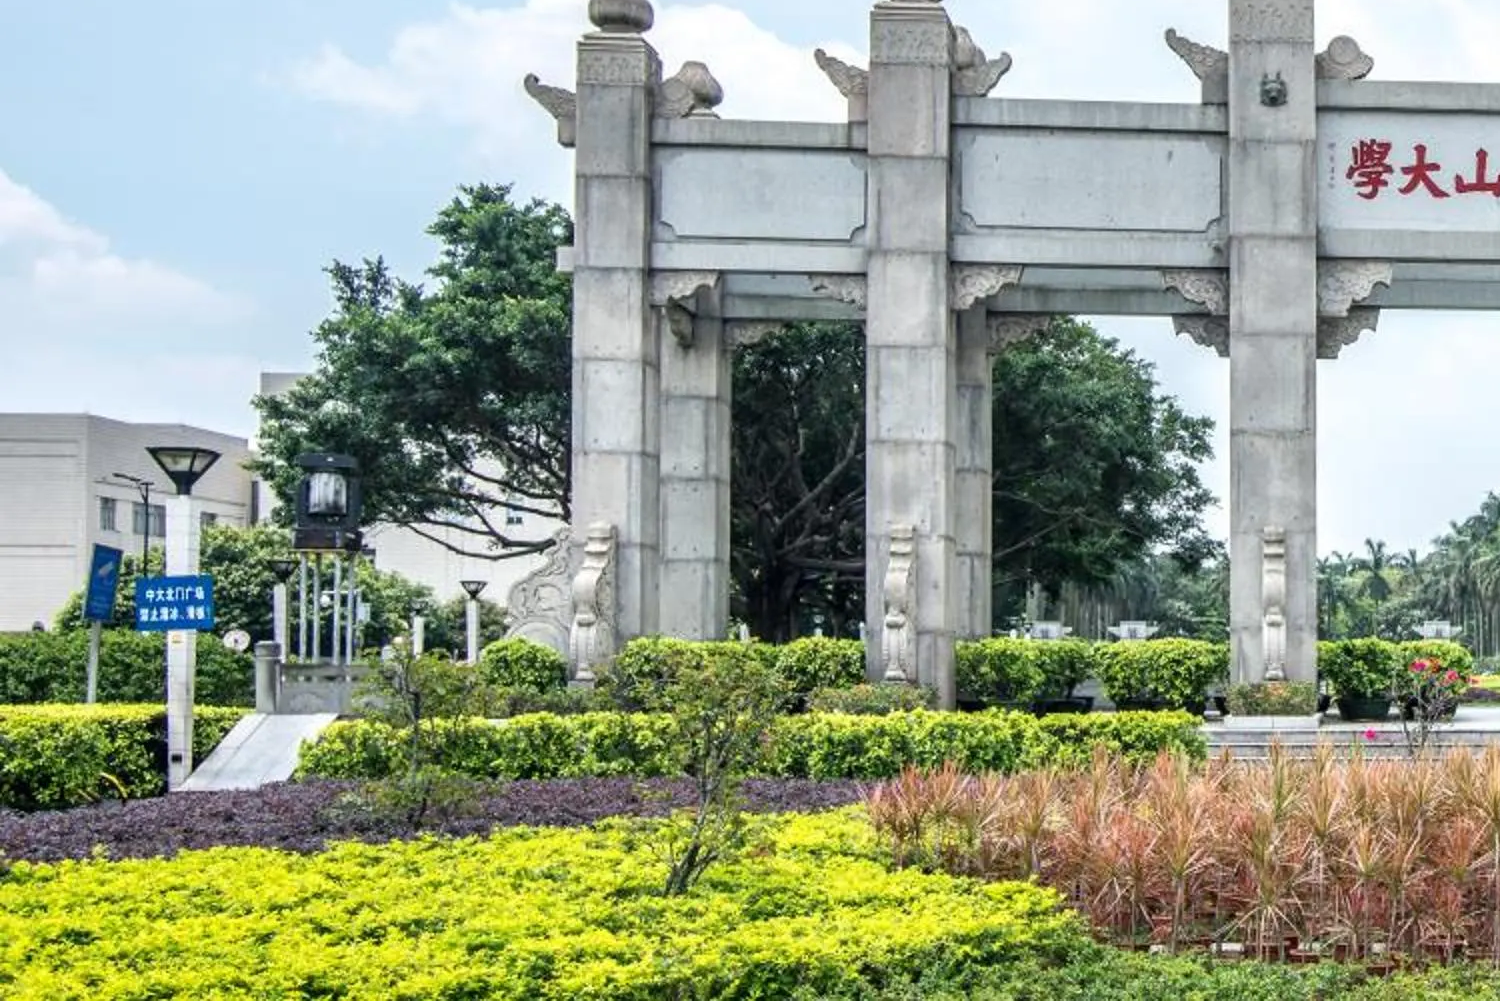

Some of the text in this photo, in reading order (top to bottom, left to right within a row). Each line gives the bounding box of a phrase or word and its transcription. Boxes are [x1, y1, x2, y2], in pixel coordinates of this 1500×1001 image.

[145, 586, 205, 603] 中大北门广场
